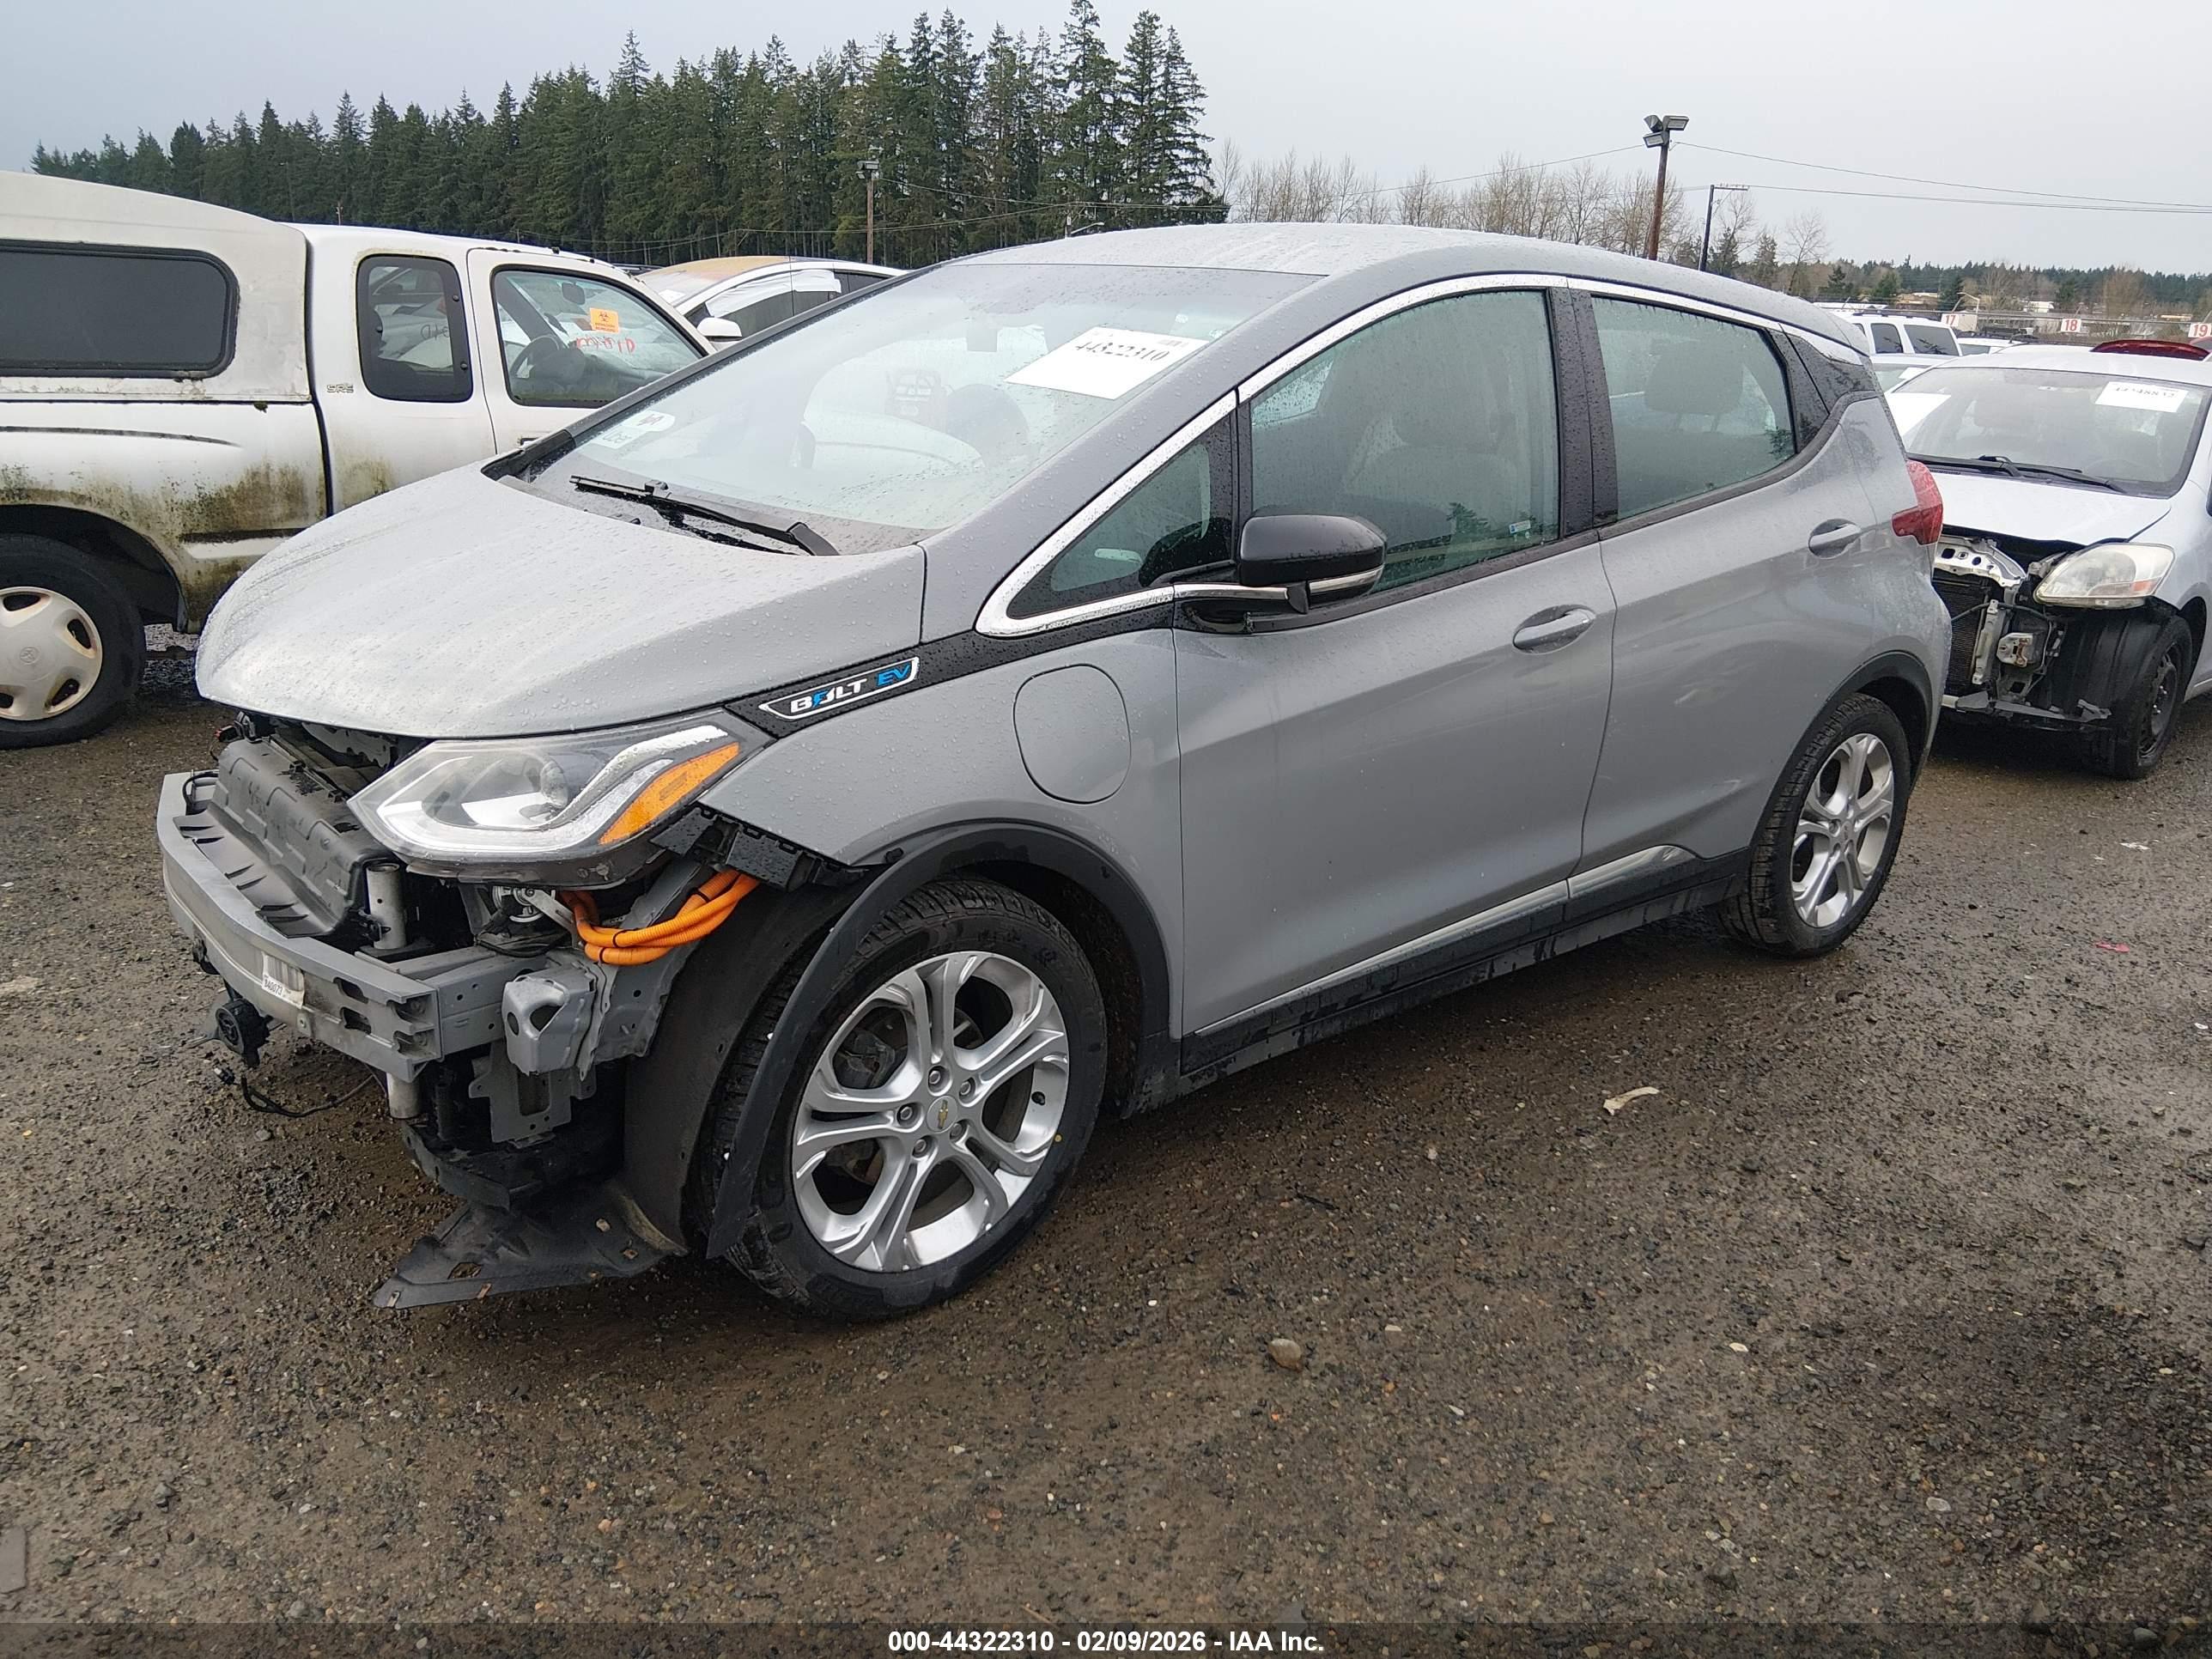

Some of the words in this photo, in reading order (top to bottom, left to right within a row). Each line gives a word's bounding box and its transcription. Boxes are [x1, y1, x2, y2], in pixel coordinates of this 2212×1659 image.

[1945, 314, 1957, 326] 17
[2064, 319, 2079, 331] 18
[2193, 324, 2209, 337] 19
[790, 678, 868, 714] BOLT
[877, 664, 912, 687] EV
